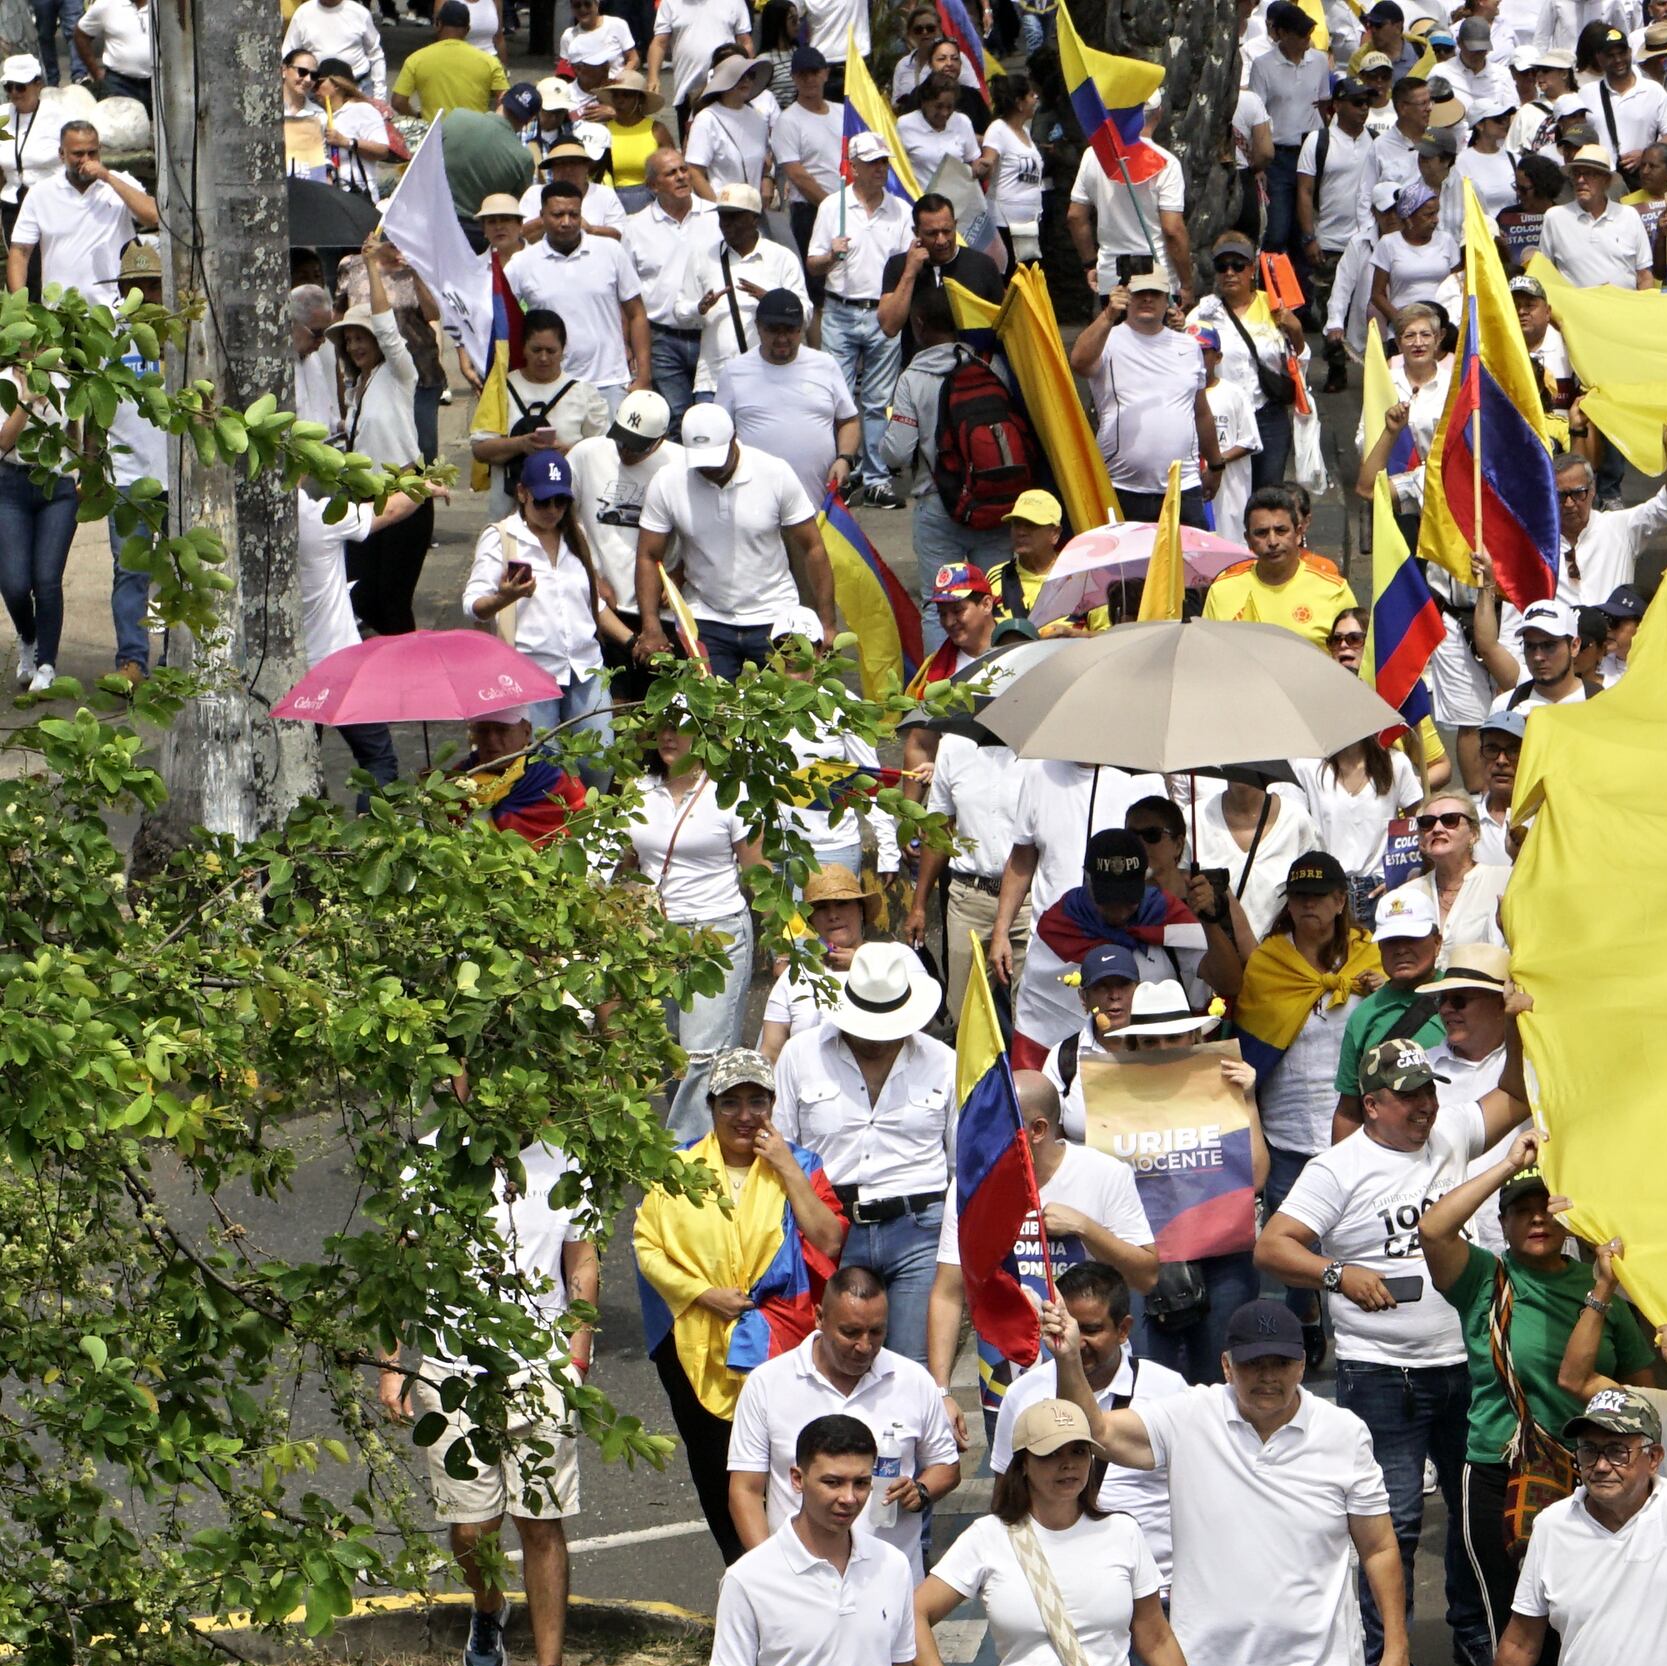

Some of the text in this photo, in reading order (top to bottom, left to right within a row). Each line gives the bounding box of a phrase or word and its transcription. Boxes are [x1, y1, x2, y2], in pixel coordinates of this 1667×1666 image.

[549, 463, 562, 481] LA
[1291, 870, 1324, 882] LIBRE
[1112, 1124, 1223, 1158] URIBE
[1132, 1151, 1224, 1176] OCENTE
